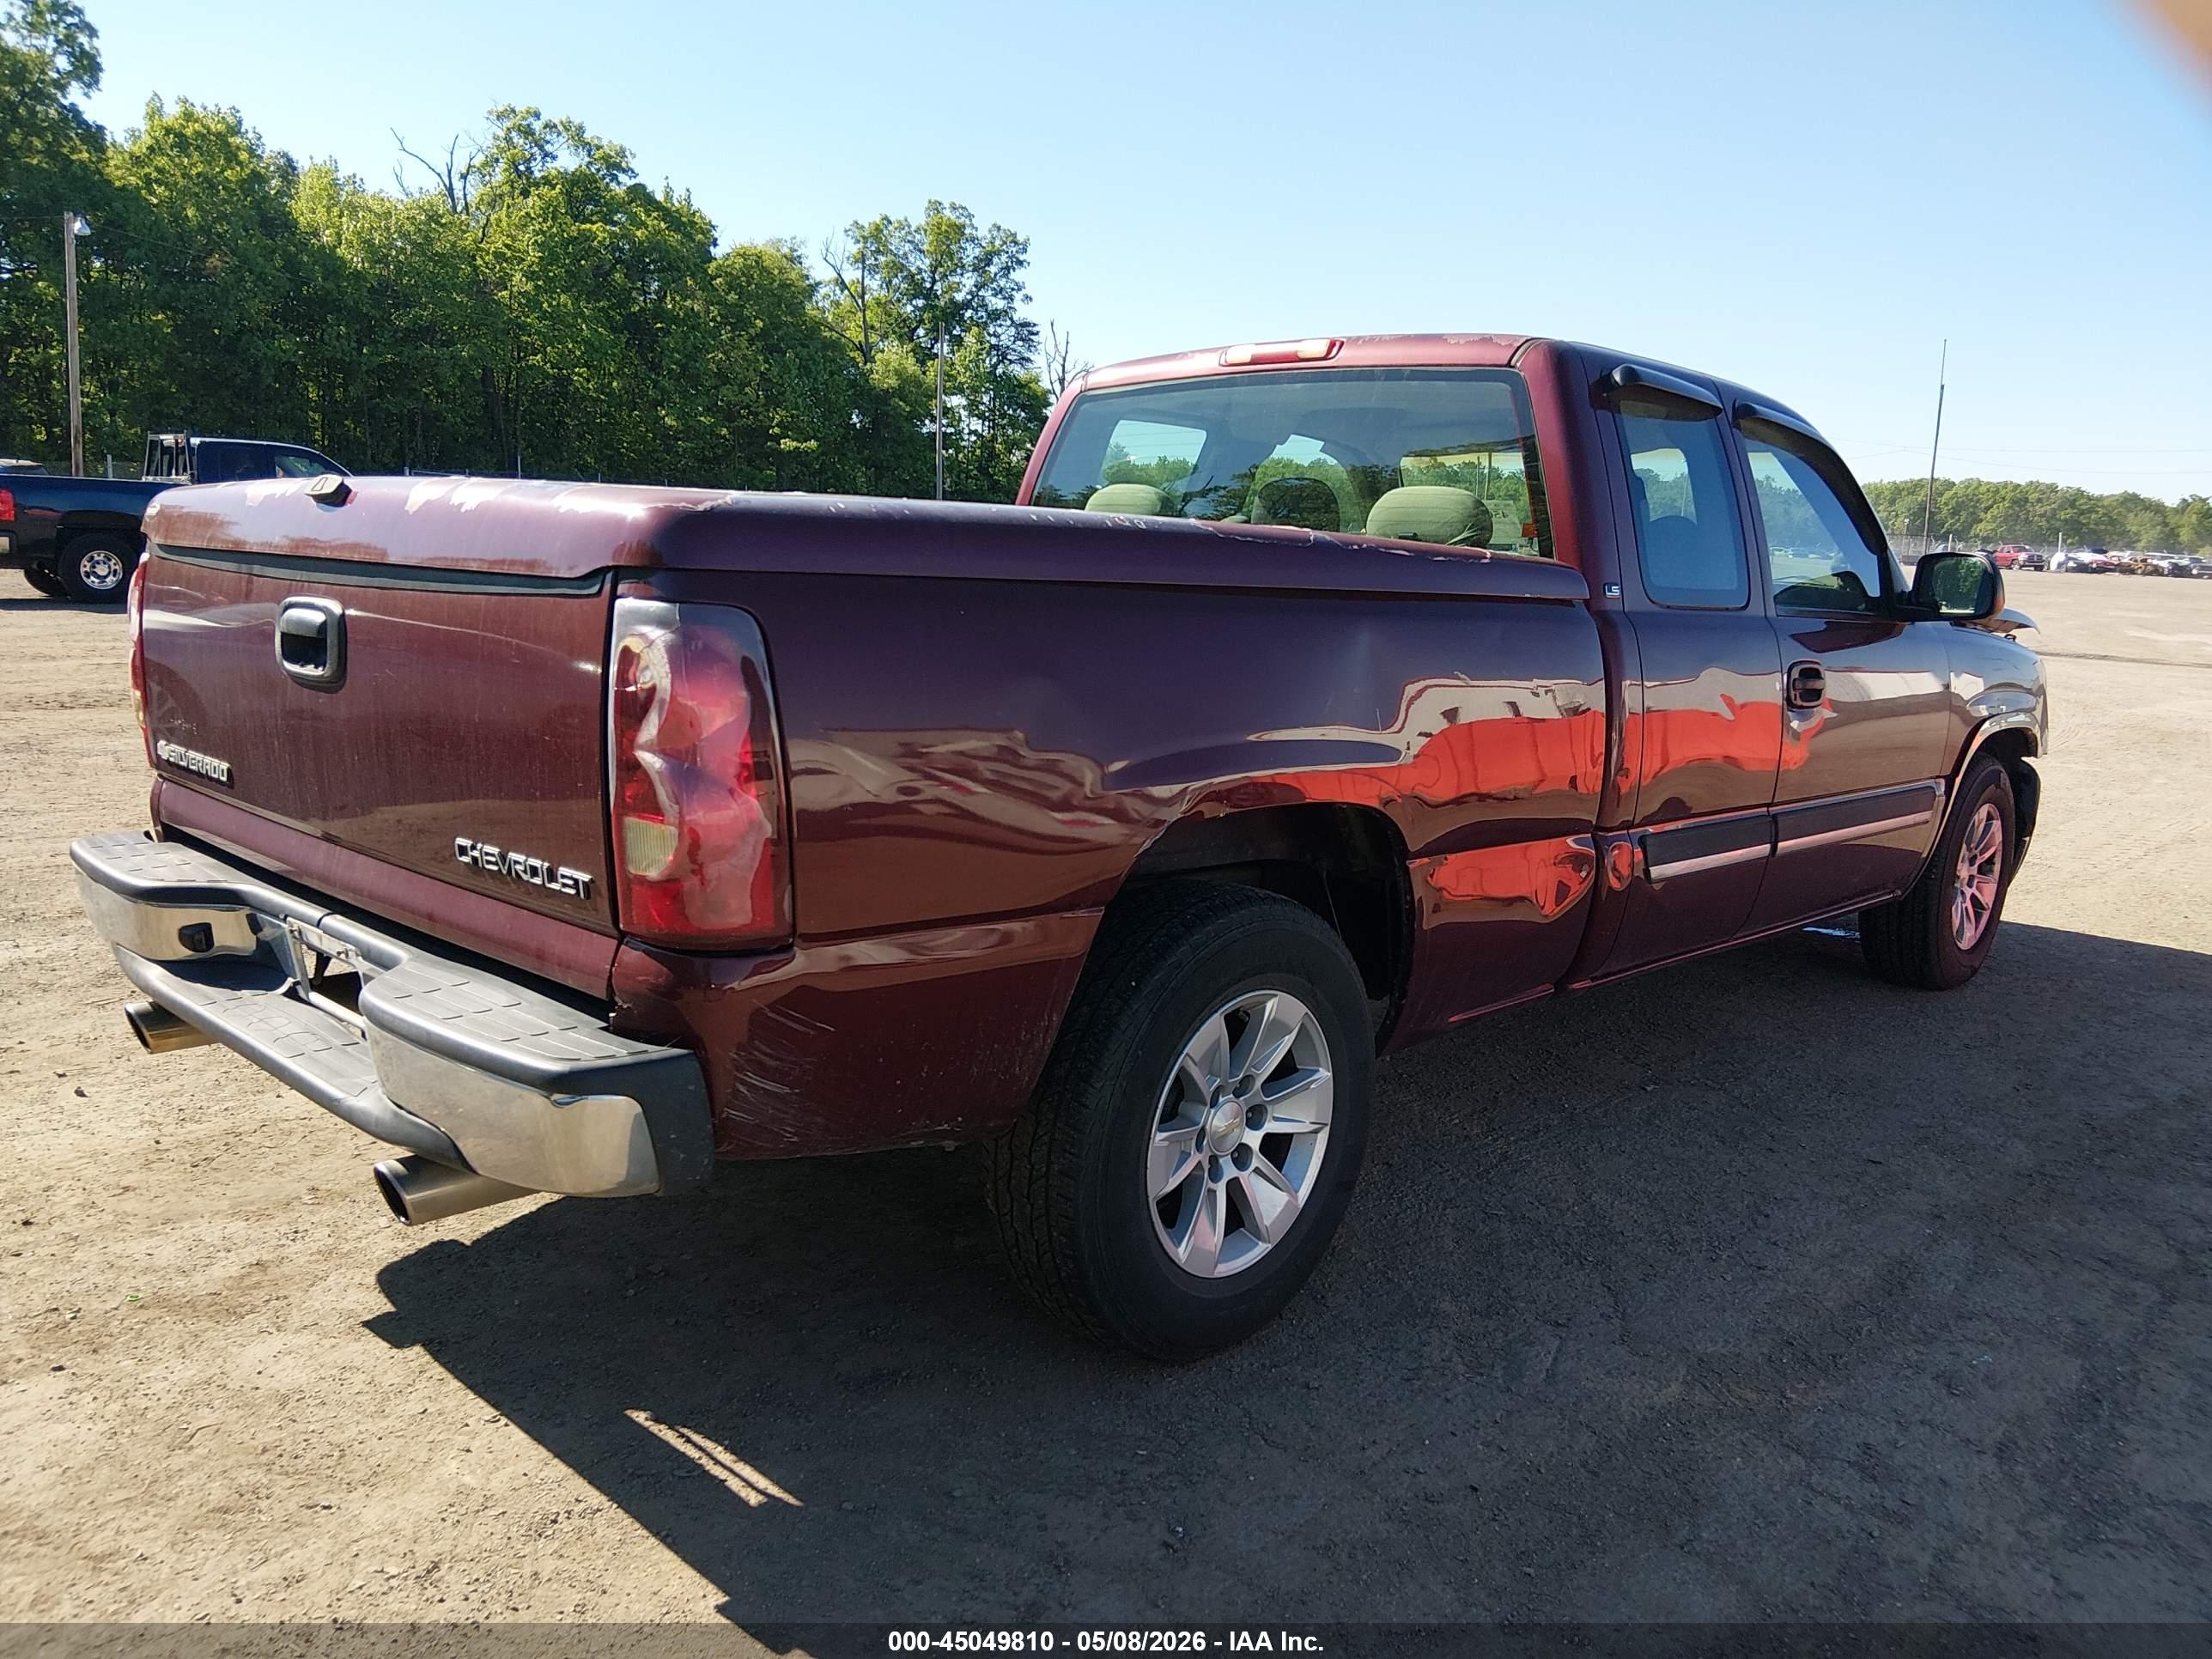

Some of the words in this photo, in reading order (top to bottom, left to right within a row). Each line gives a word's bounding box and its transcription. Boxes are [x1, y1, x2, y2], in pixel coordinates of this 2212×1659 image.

[1605, 586, 1620, 598] LS
[166, 743, 232, 782] SILVERADO
[454, 837, 594, 900] CHEVROLET
